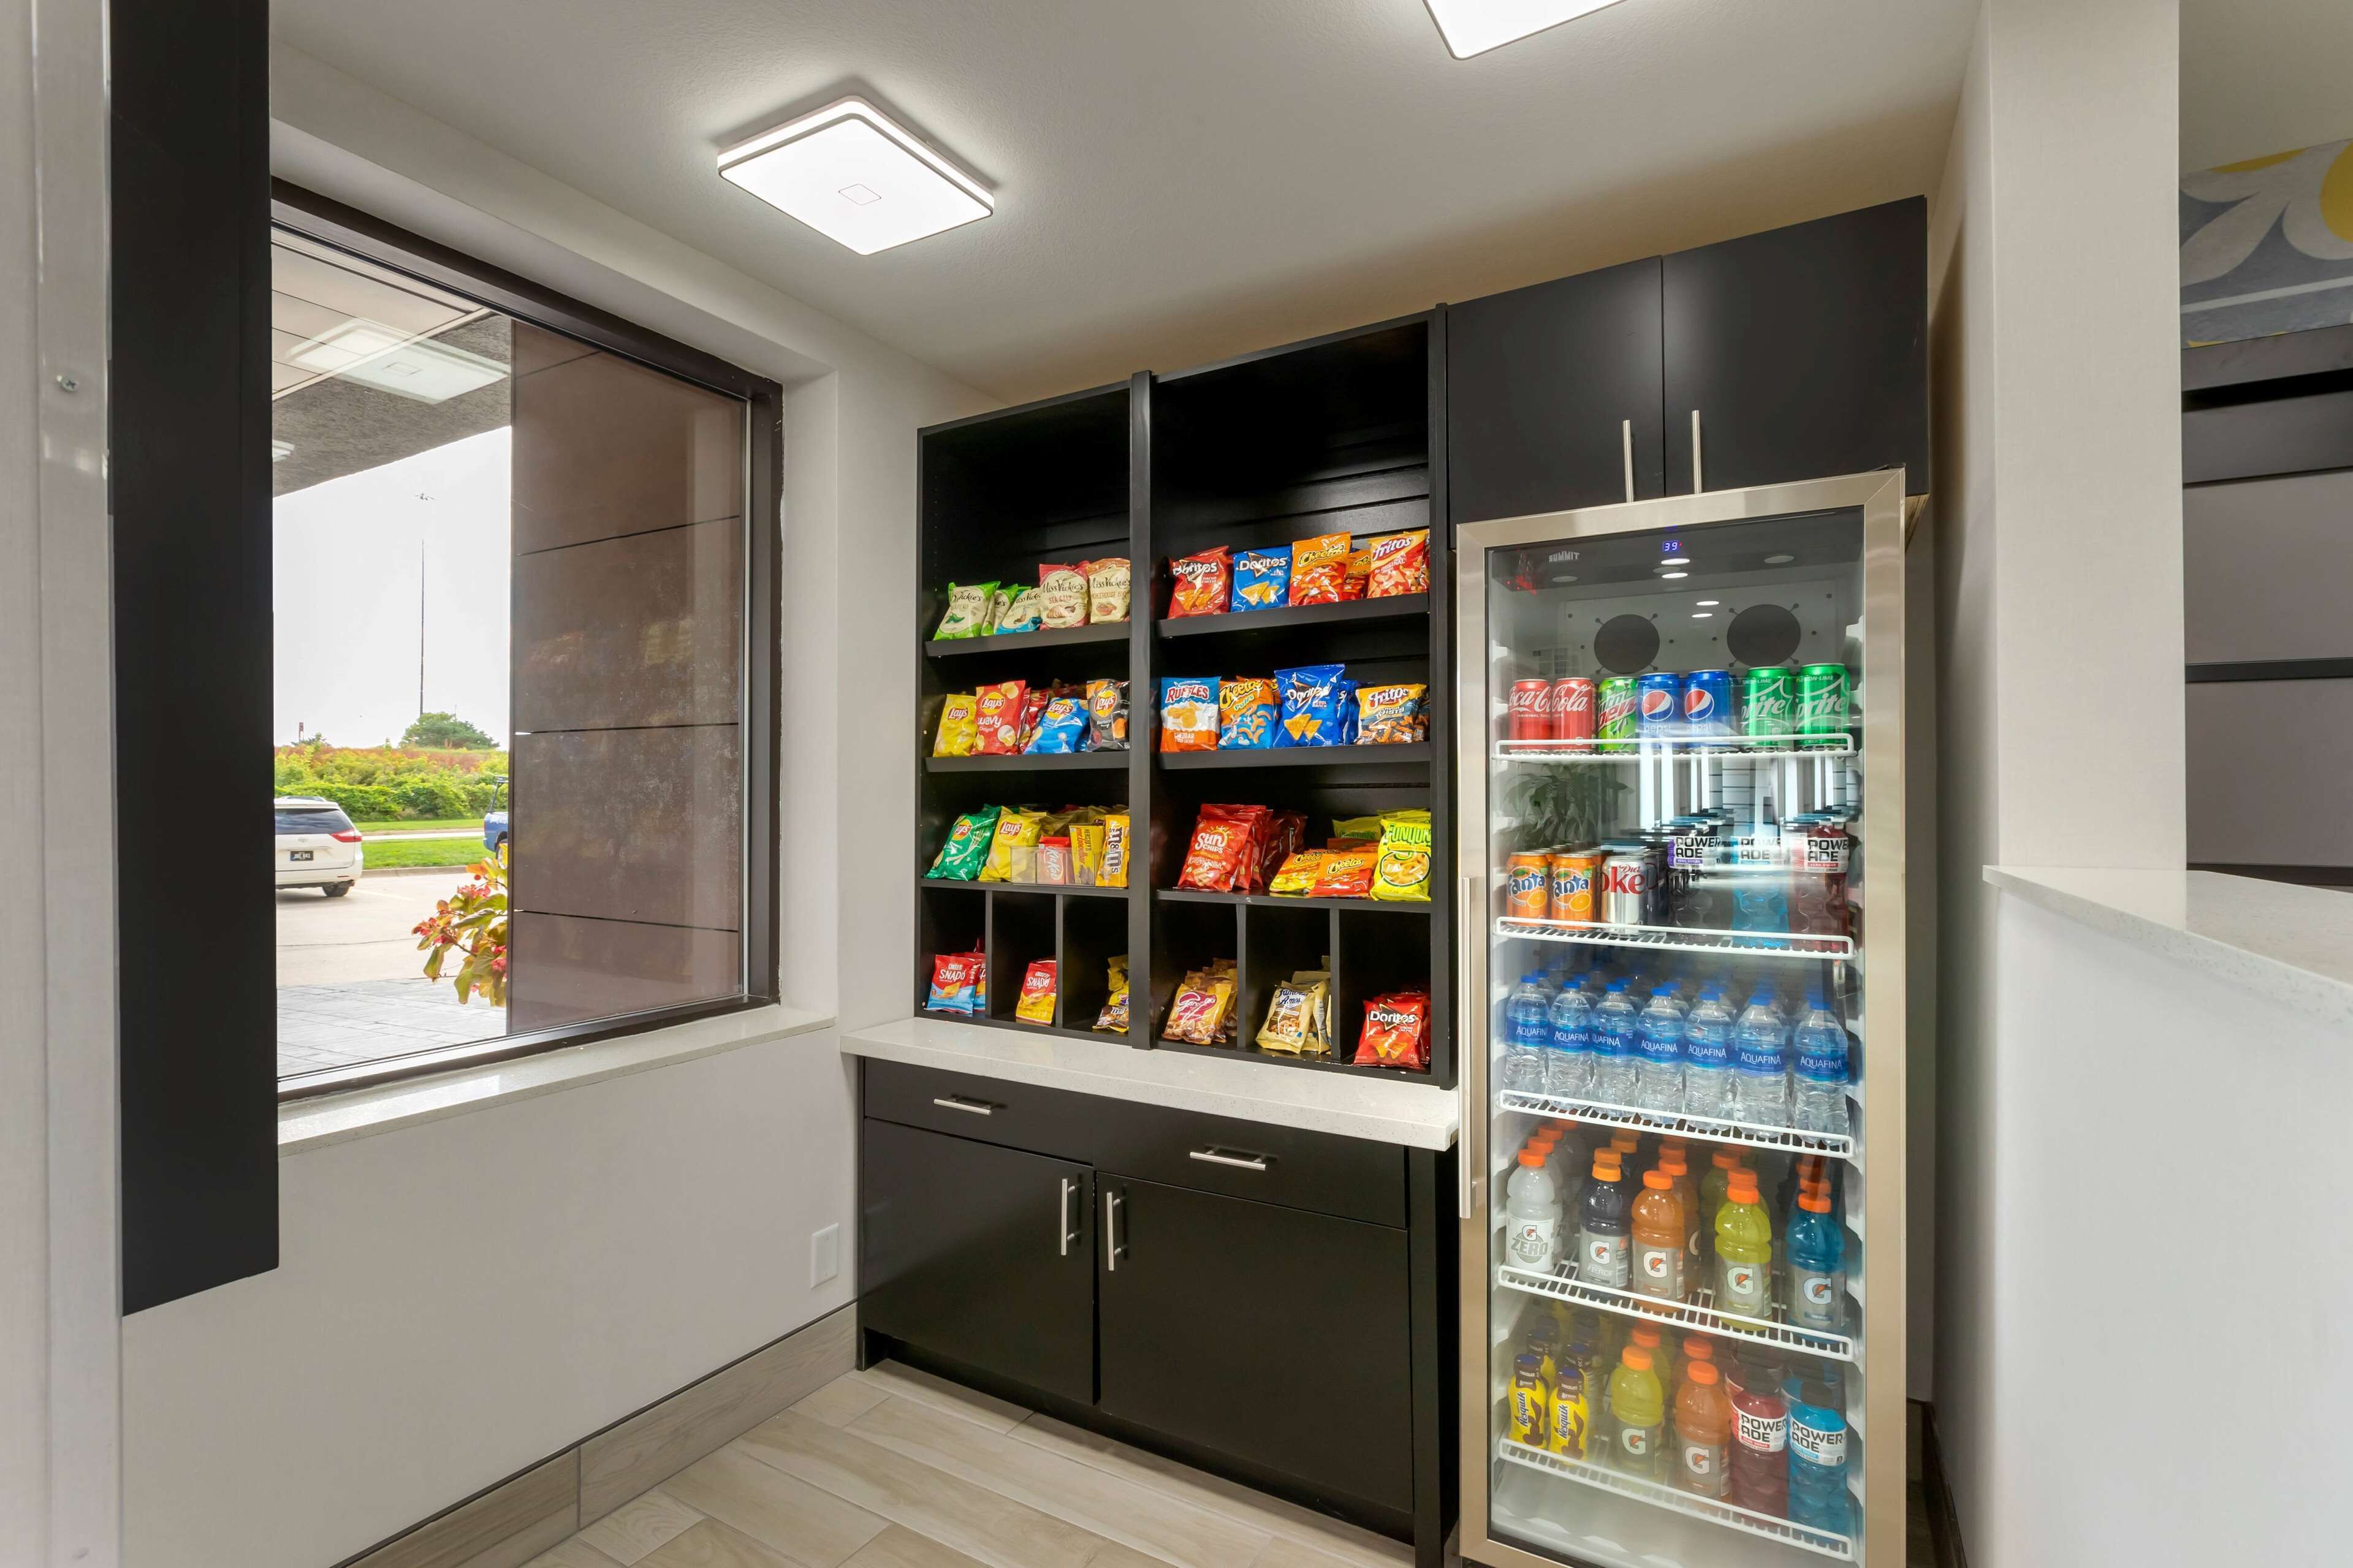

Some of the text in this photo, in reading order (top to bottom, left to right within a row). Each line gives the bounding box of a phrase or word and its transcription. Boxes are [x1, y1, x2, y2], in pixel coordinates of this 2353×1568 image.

[1664, 542, 1678, 551] 39
[1240, 557, 1287, 571] Doritos
[1549, 551, 1579, 562] SUMMIT
[1056, 579, 1083, 593] Vickie's
[1165, 685, 1209, 703] RUFFLES
[1219, 680, 1263, 710] Cheetos
[1368, 687, 1408, 709] Fritos
[1510, 686, 1551, 712] Coca-Co
[981, 698, 1004, 710] Lay's
[1096, 696, 1115, 711] Lay's
[1796, 692, 1844, 724] prite
[949, 708, 968, 721] Lay's
[1644, 722, 1672, 732] pepsi
[1687, 722, 1712, 732] pepsi
[1000, 821, 1022, 835] Lay's
[1384, 823, 1431, 847] FUNYUN
[1203, 844, 1224, 854] CHIPS
[1676, 836, 1721, 847] POWER
[1808, 839, 1849, 850] POWE
[1676, 848, 1703, 858] ADE
[1741, 850, 1770, 860] ADE
[1808, 851, 1838, 862] ADE
[1327, 858, 1364, 875] Cheetos
[1619, 864, 1641, 873] Diet
[1602, 866, 1646, 895] oke
[1370, 1010, 1417, 1023] Doritos
[1554, 1031, 1589, 1042] AQUAFINA
[1593, 1033, 1621, 1048] QUAFINA
[1641, 1039, 1678, 1053] AQUAFINA
[1688, 1043, 1727, 1058] AQUAFINA
[1741, 1051, 1781, 1065] AQUAFINA
[1800, 1056, 1842, 1069] AQUAFINA
[1511, 1237, 1549, 1256] ZERO
[1589, 1241, 1610, 1264] G
[1643, 1251, 1667, 1278] G
[1727, 1267, 1754, 1295] G
[1804, 1278, 1832, 1305] G
[1517, 1392, 1533, 1428] Nesquik
[1558, 1403, 1572, 1439] Nesquik
[1741, 1414, 1787, 1432] POWER
[1741, 1425, 1770, 1443] ADE
[1792, 1420, 1843, 1445] POWER
[1622, 1428, 1646, 1455] G
[1792, 1430, 1819, 1453] ADE
[1686, 1447, 1710, 1474] G
